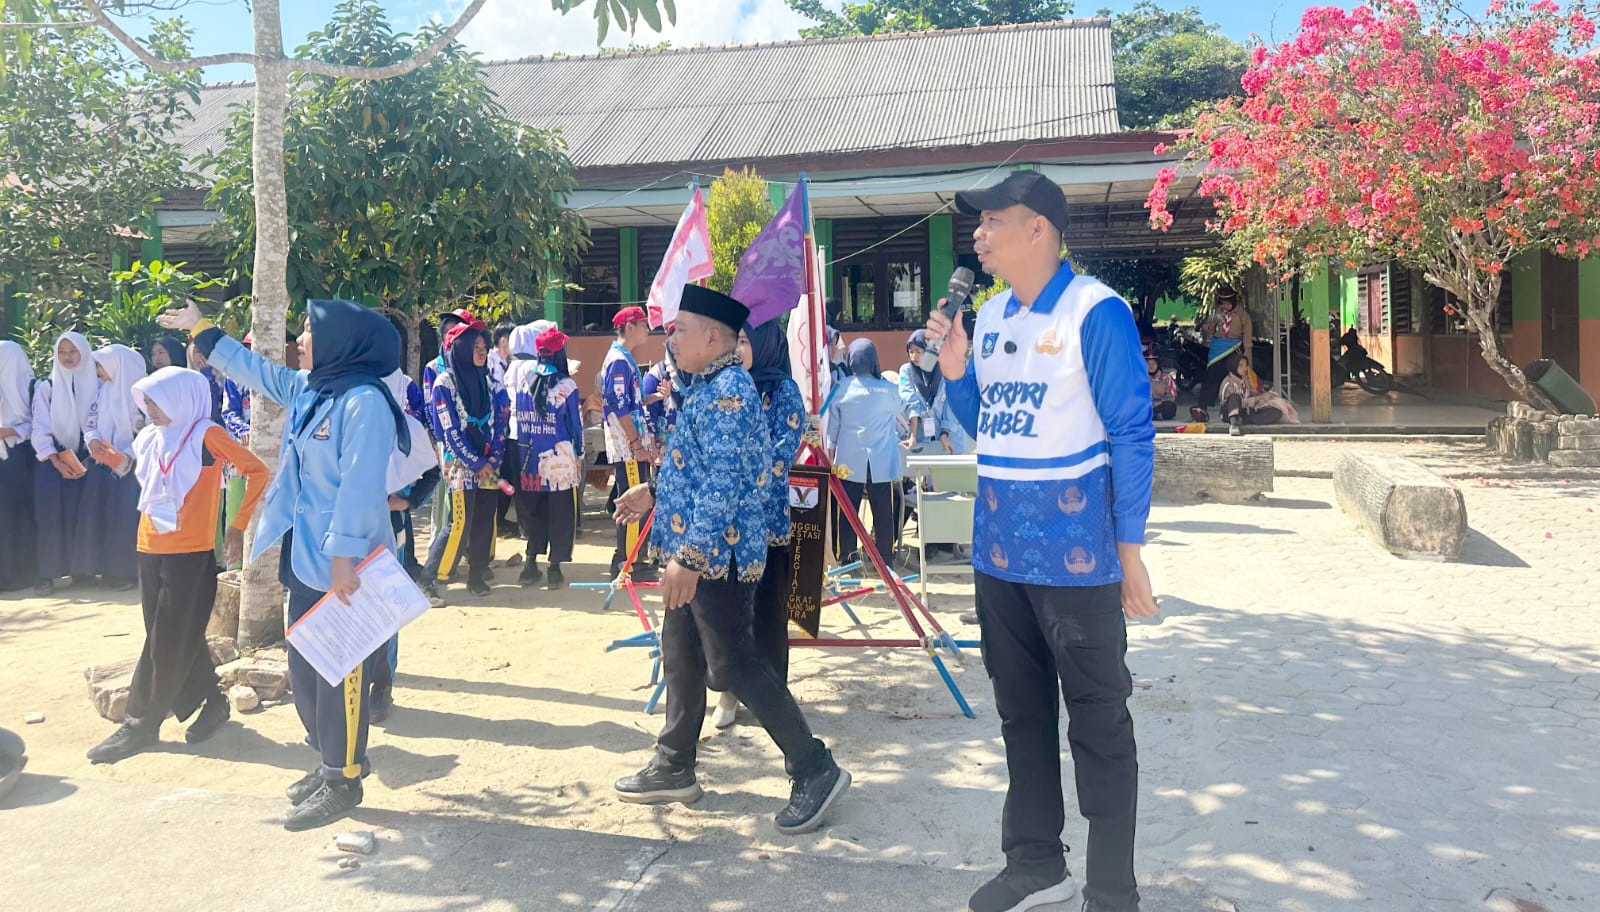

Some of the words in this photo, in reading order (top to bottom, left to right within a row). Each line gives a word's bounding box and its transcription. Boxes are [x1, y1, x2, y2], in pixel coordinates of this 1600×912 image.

[979, 410, 1038, 439] BABEL
[790, 521, 821, 532] NGGUL
[791, 530, 820, 540] ESTASI
[789, 594, 813, 604] GKAT
[787, 609, 806, 620] TRA
